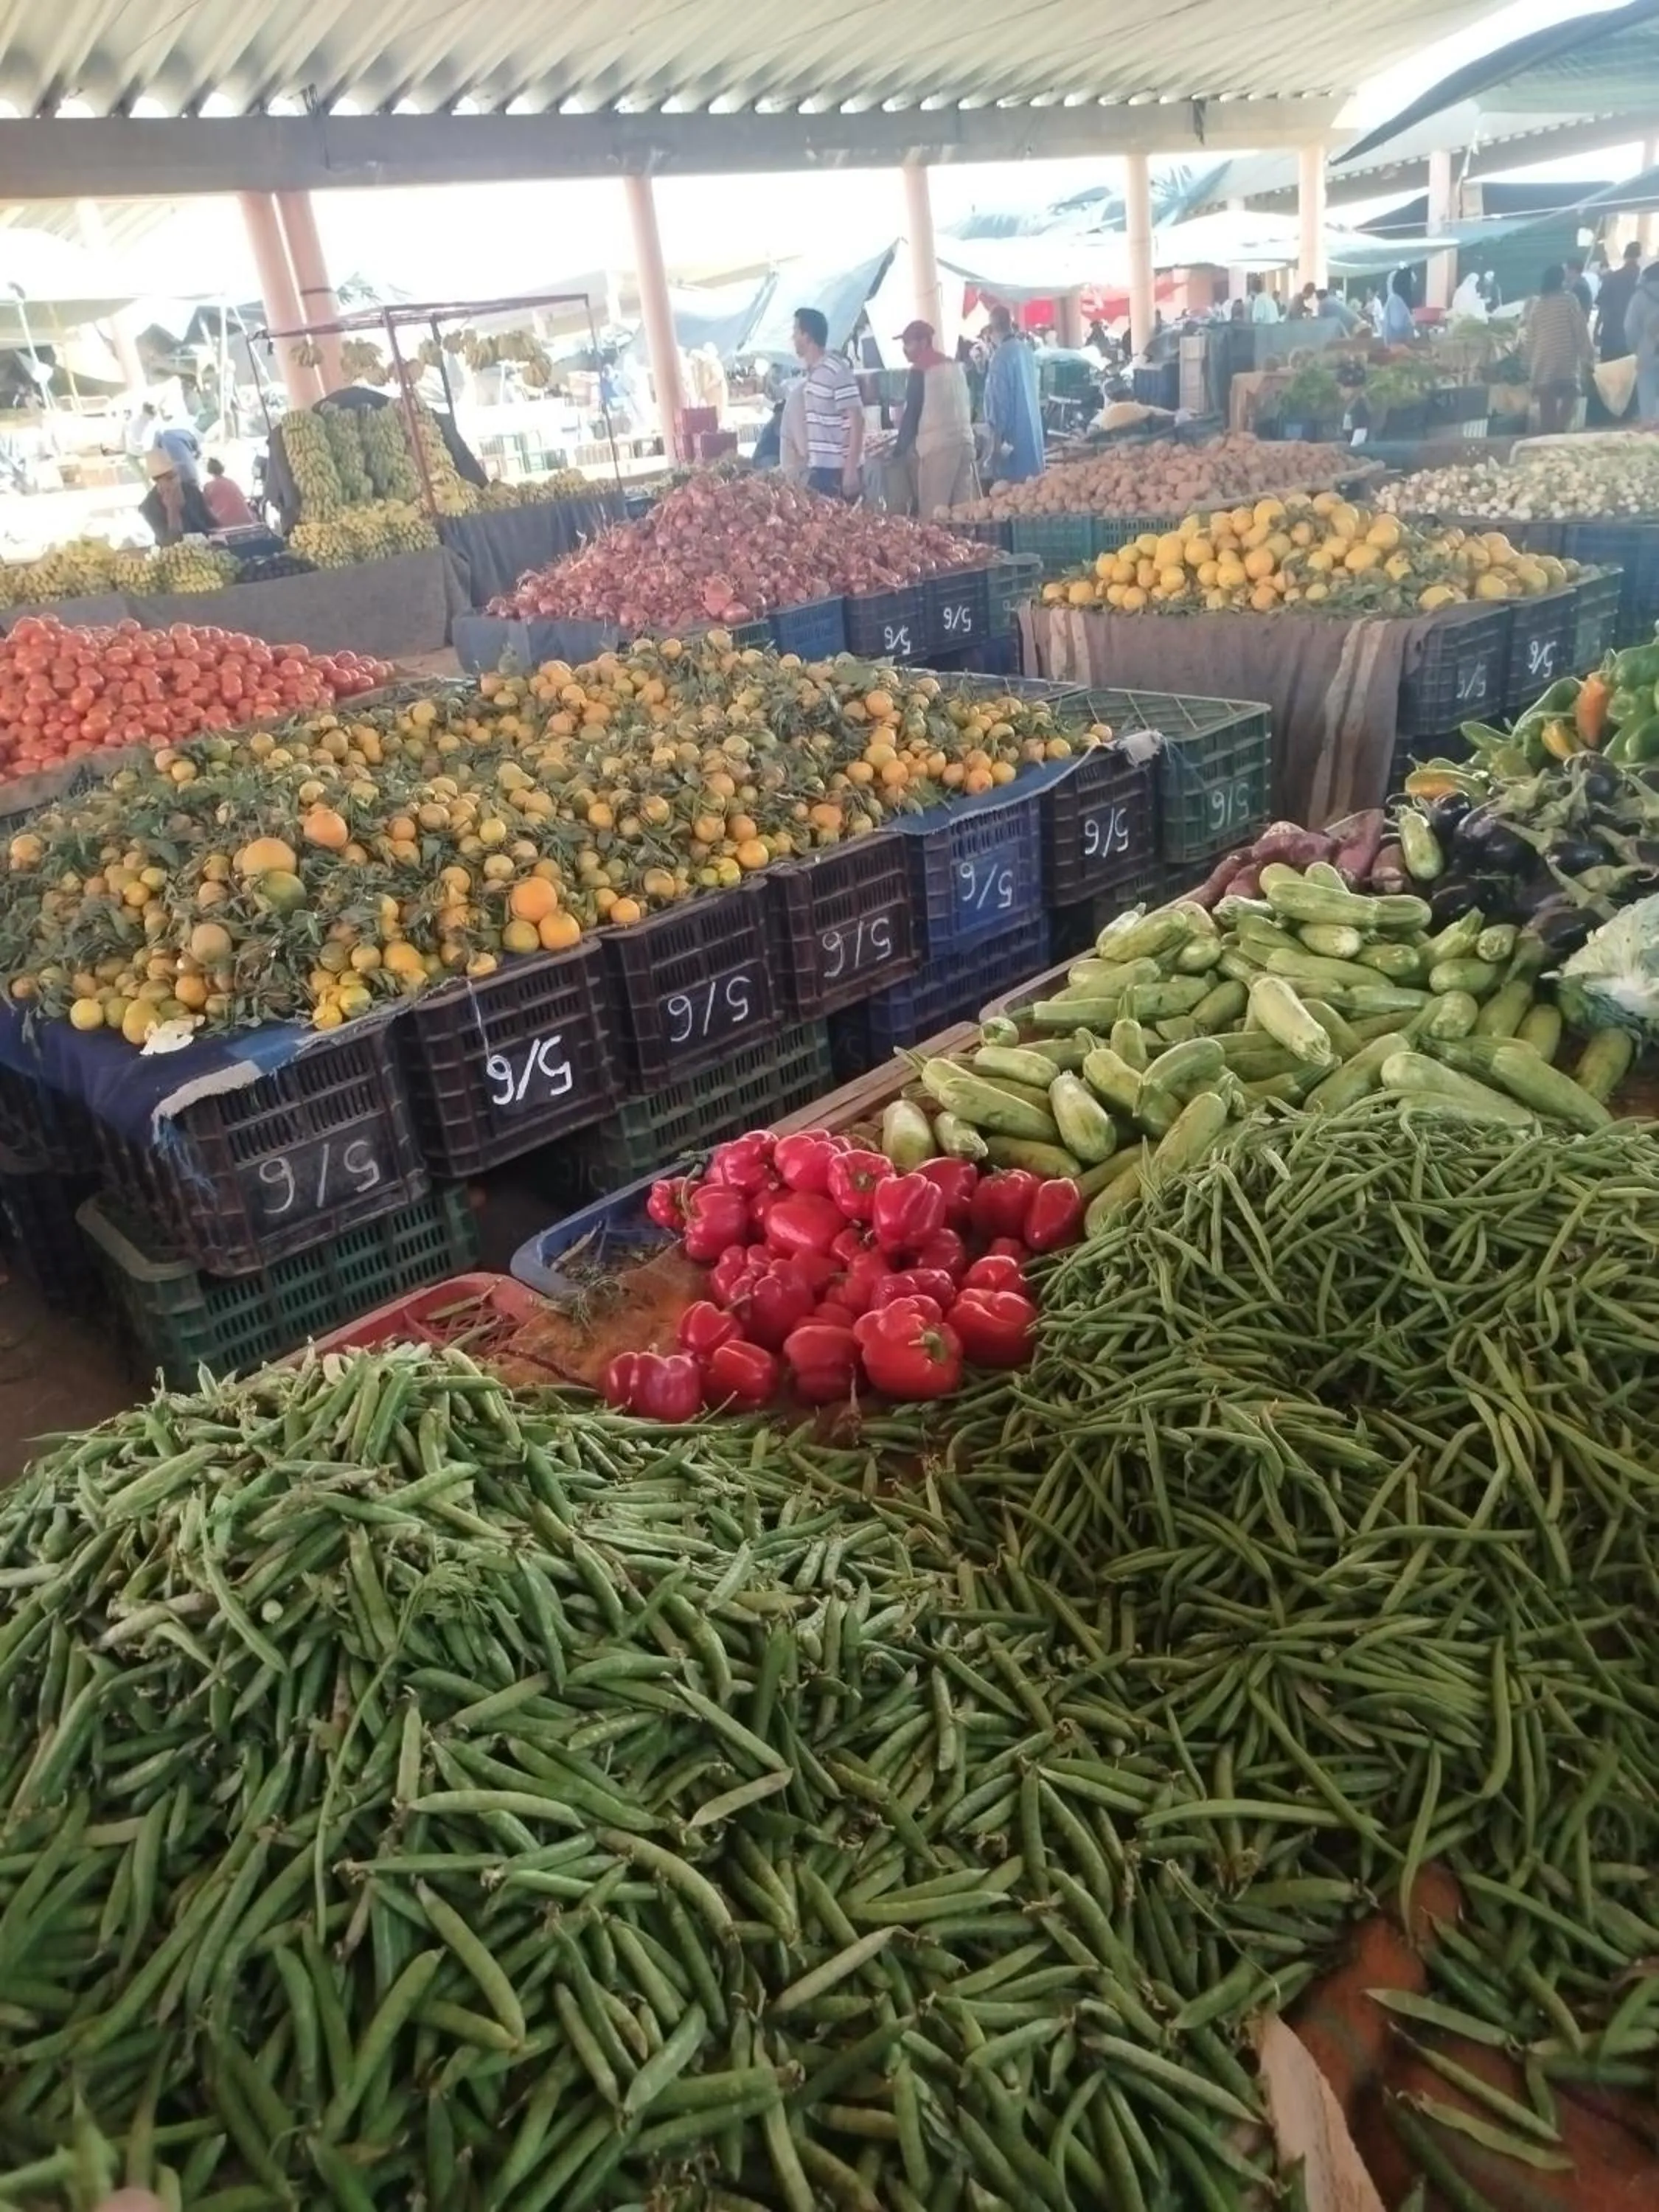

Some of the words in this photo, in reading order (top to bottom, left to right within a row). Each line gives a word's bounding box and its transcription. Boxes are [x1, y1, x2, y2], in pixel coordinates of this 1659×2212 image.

[885, 626, 911, 655] 5/6
[943, 605, 971, 632] 5/6
[1210, 783, 1249, 830] 5/6
[1085, 807, 1129, 859] 5/6
[960, 862, 1012, 909] 5/6
[822, 917, 891, 978] 5/6
[666, 976, 751, 1042] 5/6
[486, 1034, 573, 1105] 5/6
[260, 1140, 380, 1214] 5/6
